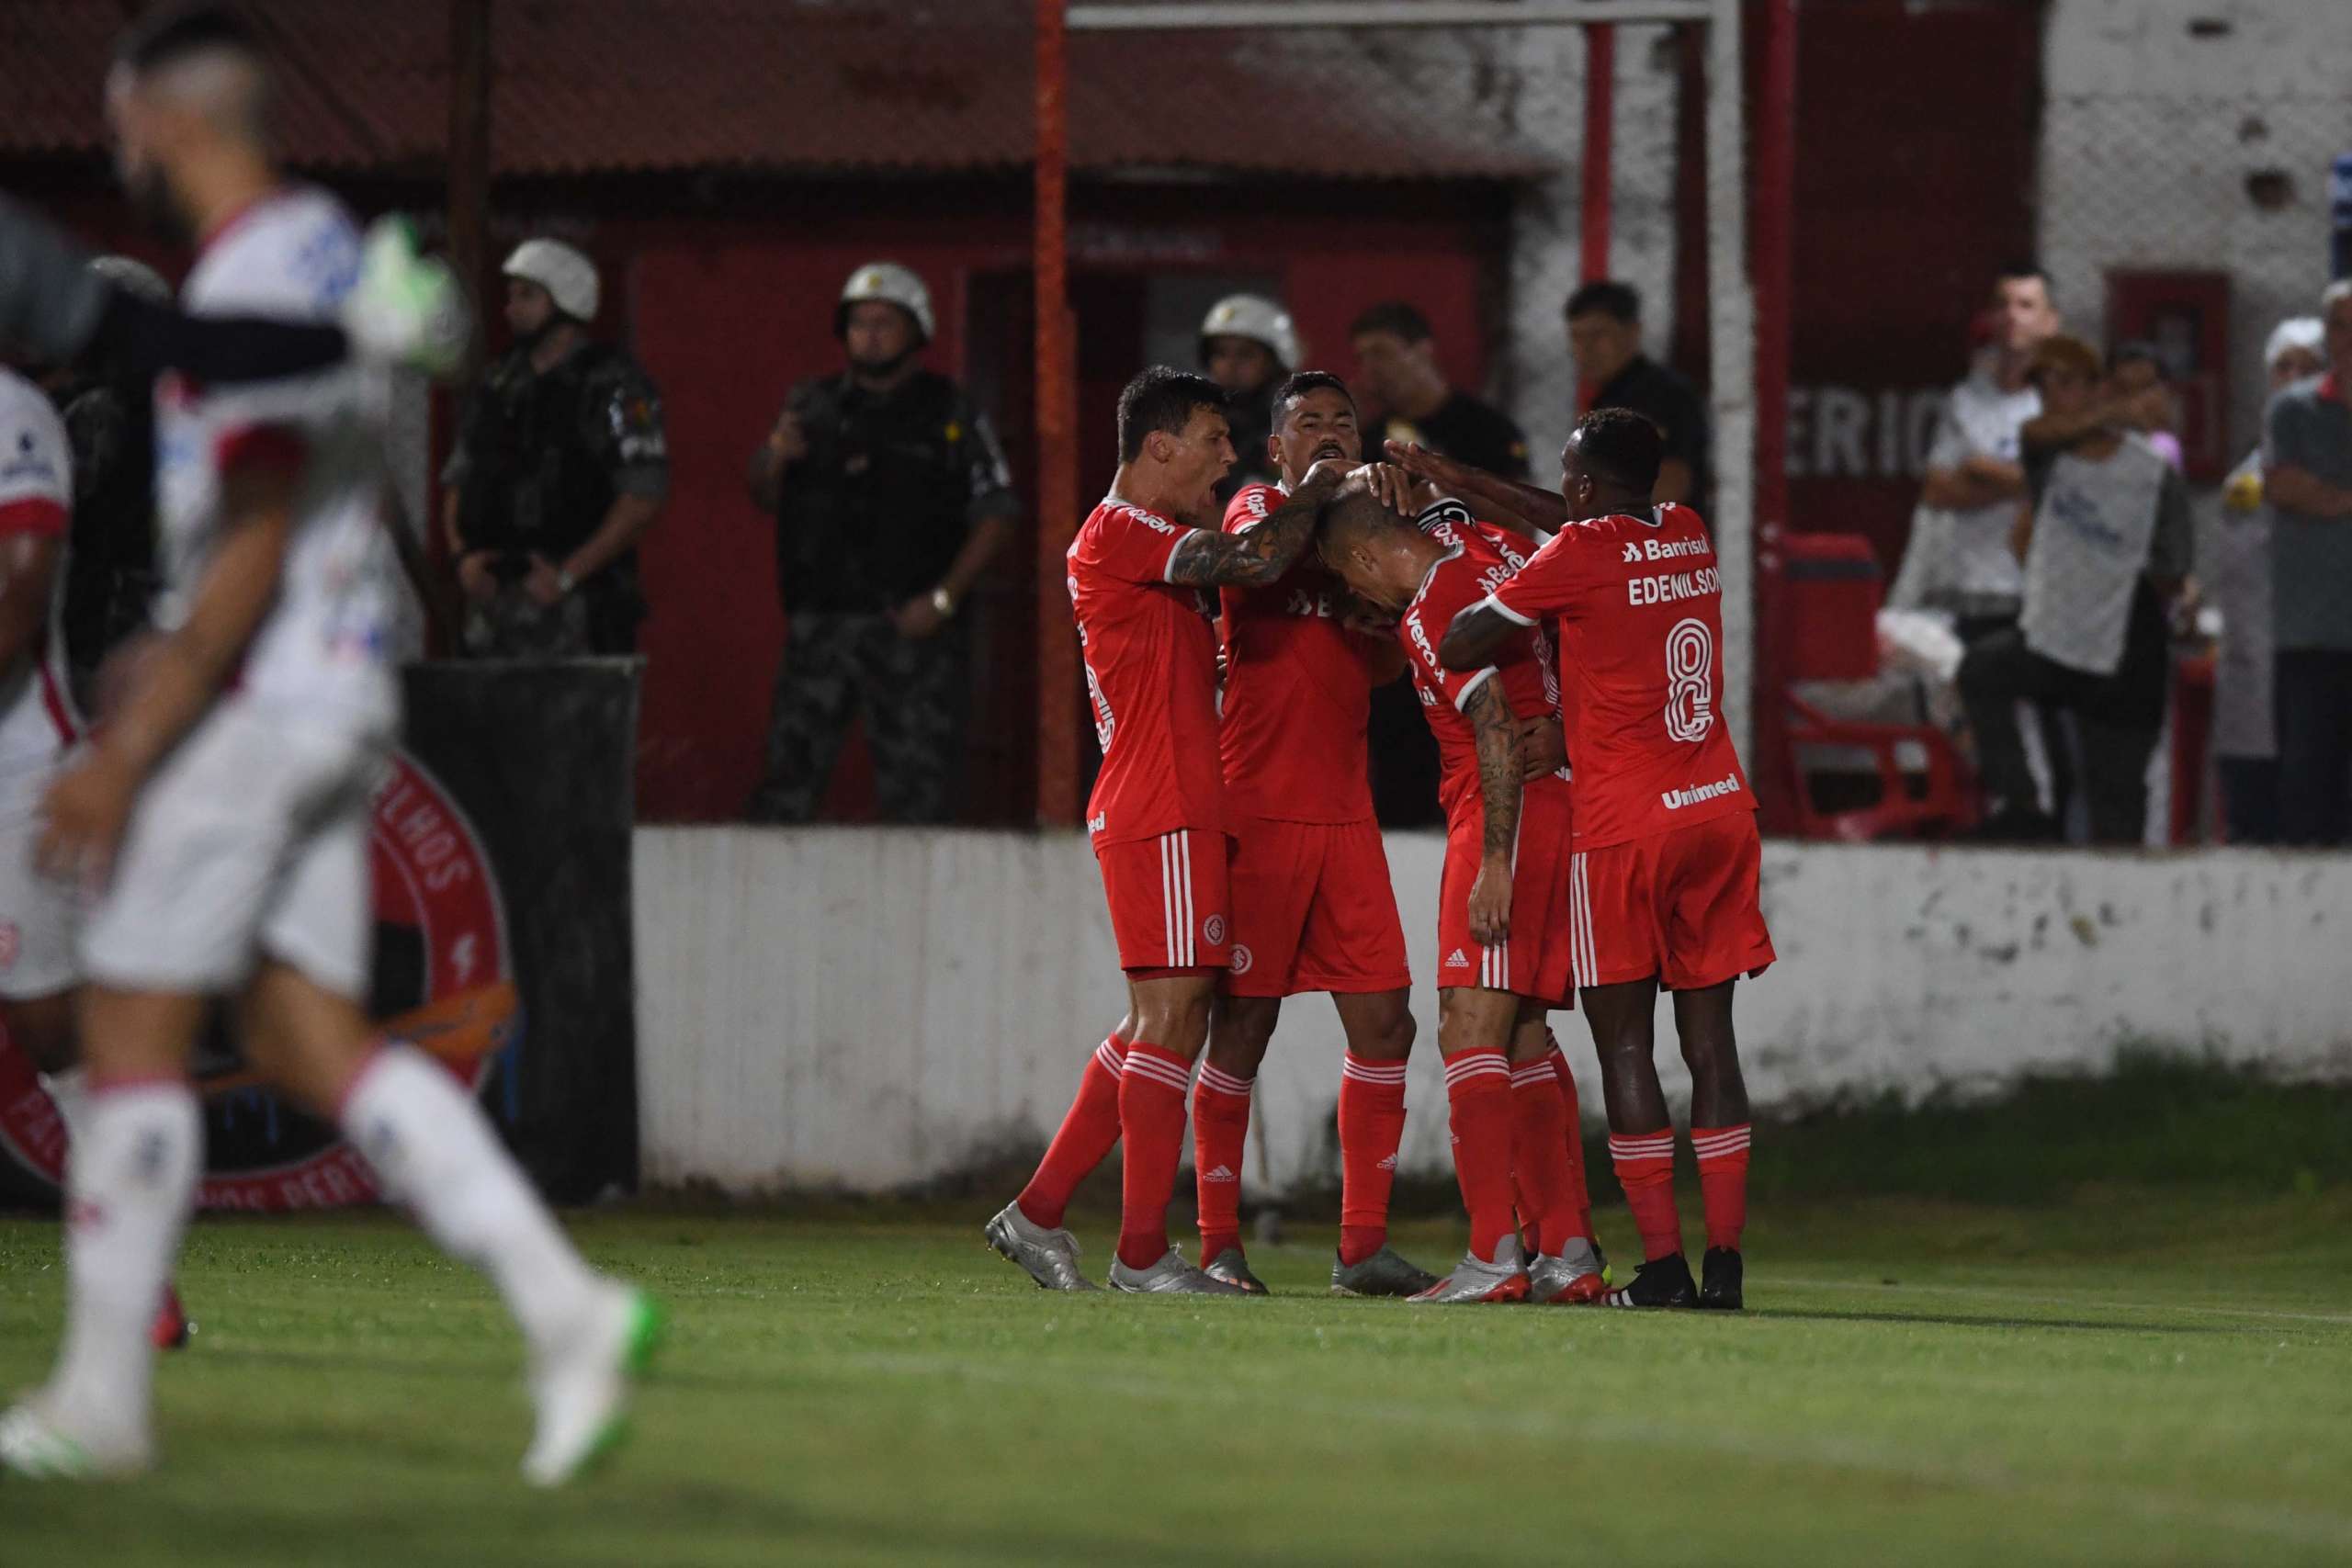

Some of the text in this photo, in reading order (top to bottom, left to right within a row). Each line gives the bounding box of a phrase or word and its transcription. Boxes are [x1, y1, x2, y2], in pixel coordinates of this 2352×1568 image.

[1127, 507, 1176, 537] vero
[1644, 534, 1710, 561] Banrisul
[1628, 566, 1722, 606] EDENILSON
[1406, 607, 1437, 668] vero
[1664, 617, 1715, 743] 8
[1661, 773, 1741, 810] Unimed
